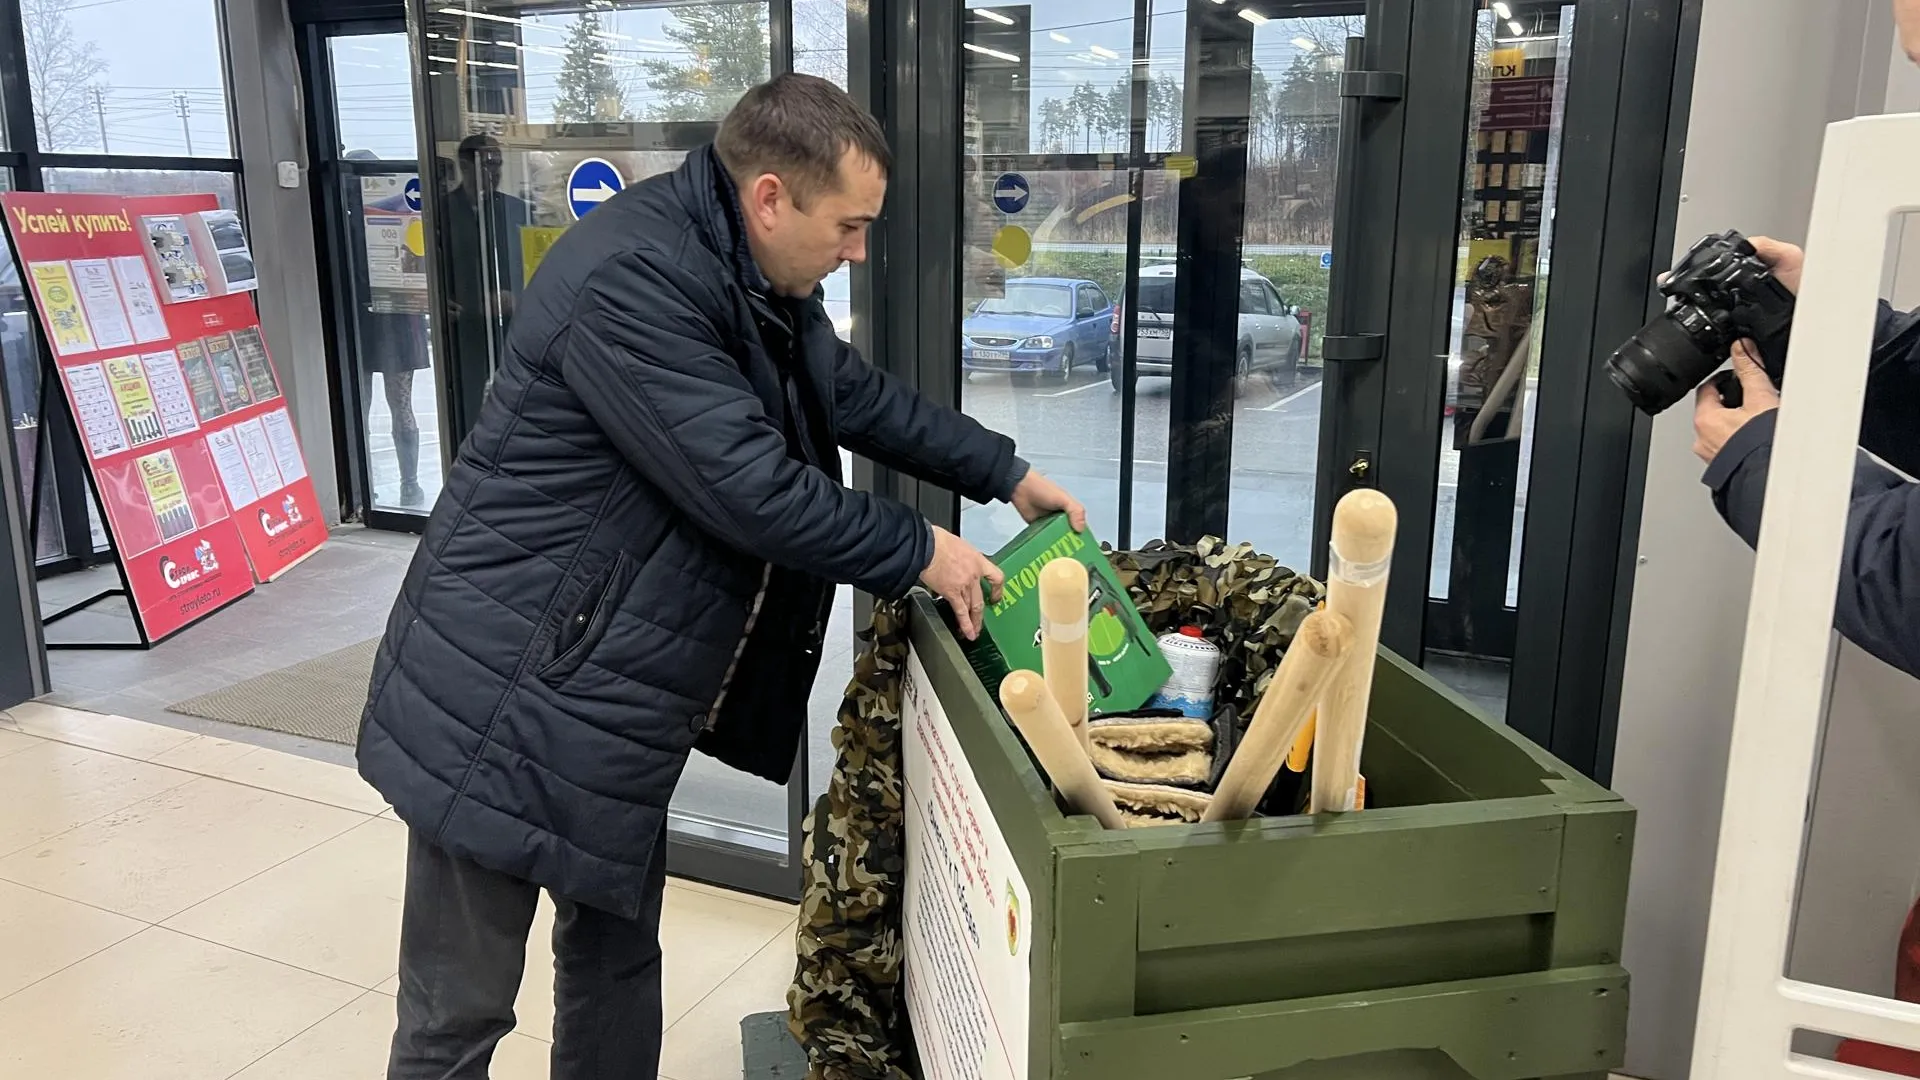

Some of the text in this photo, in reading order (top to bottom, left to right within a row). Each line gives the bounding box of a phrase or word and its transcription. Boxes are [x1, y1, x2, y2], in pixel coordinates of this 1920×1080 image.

[12, 207, 133, 239] Успей купить!
[180, 588, 221, 615] stroyleto.ru
